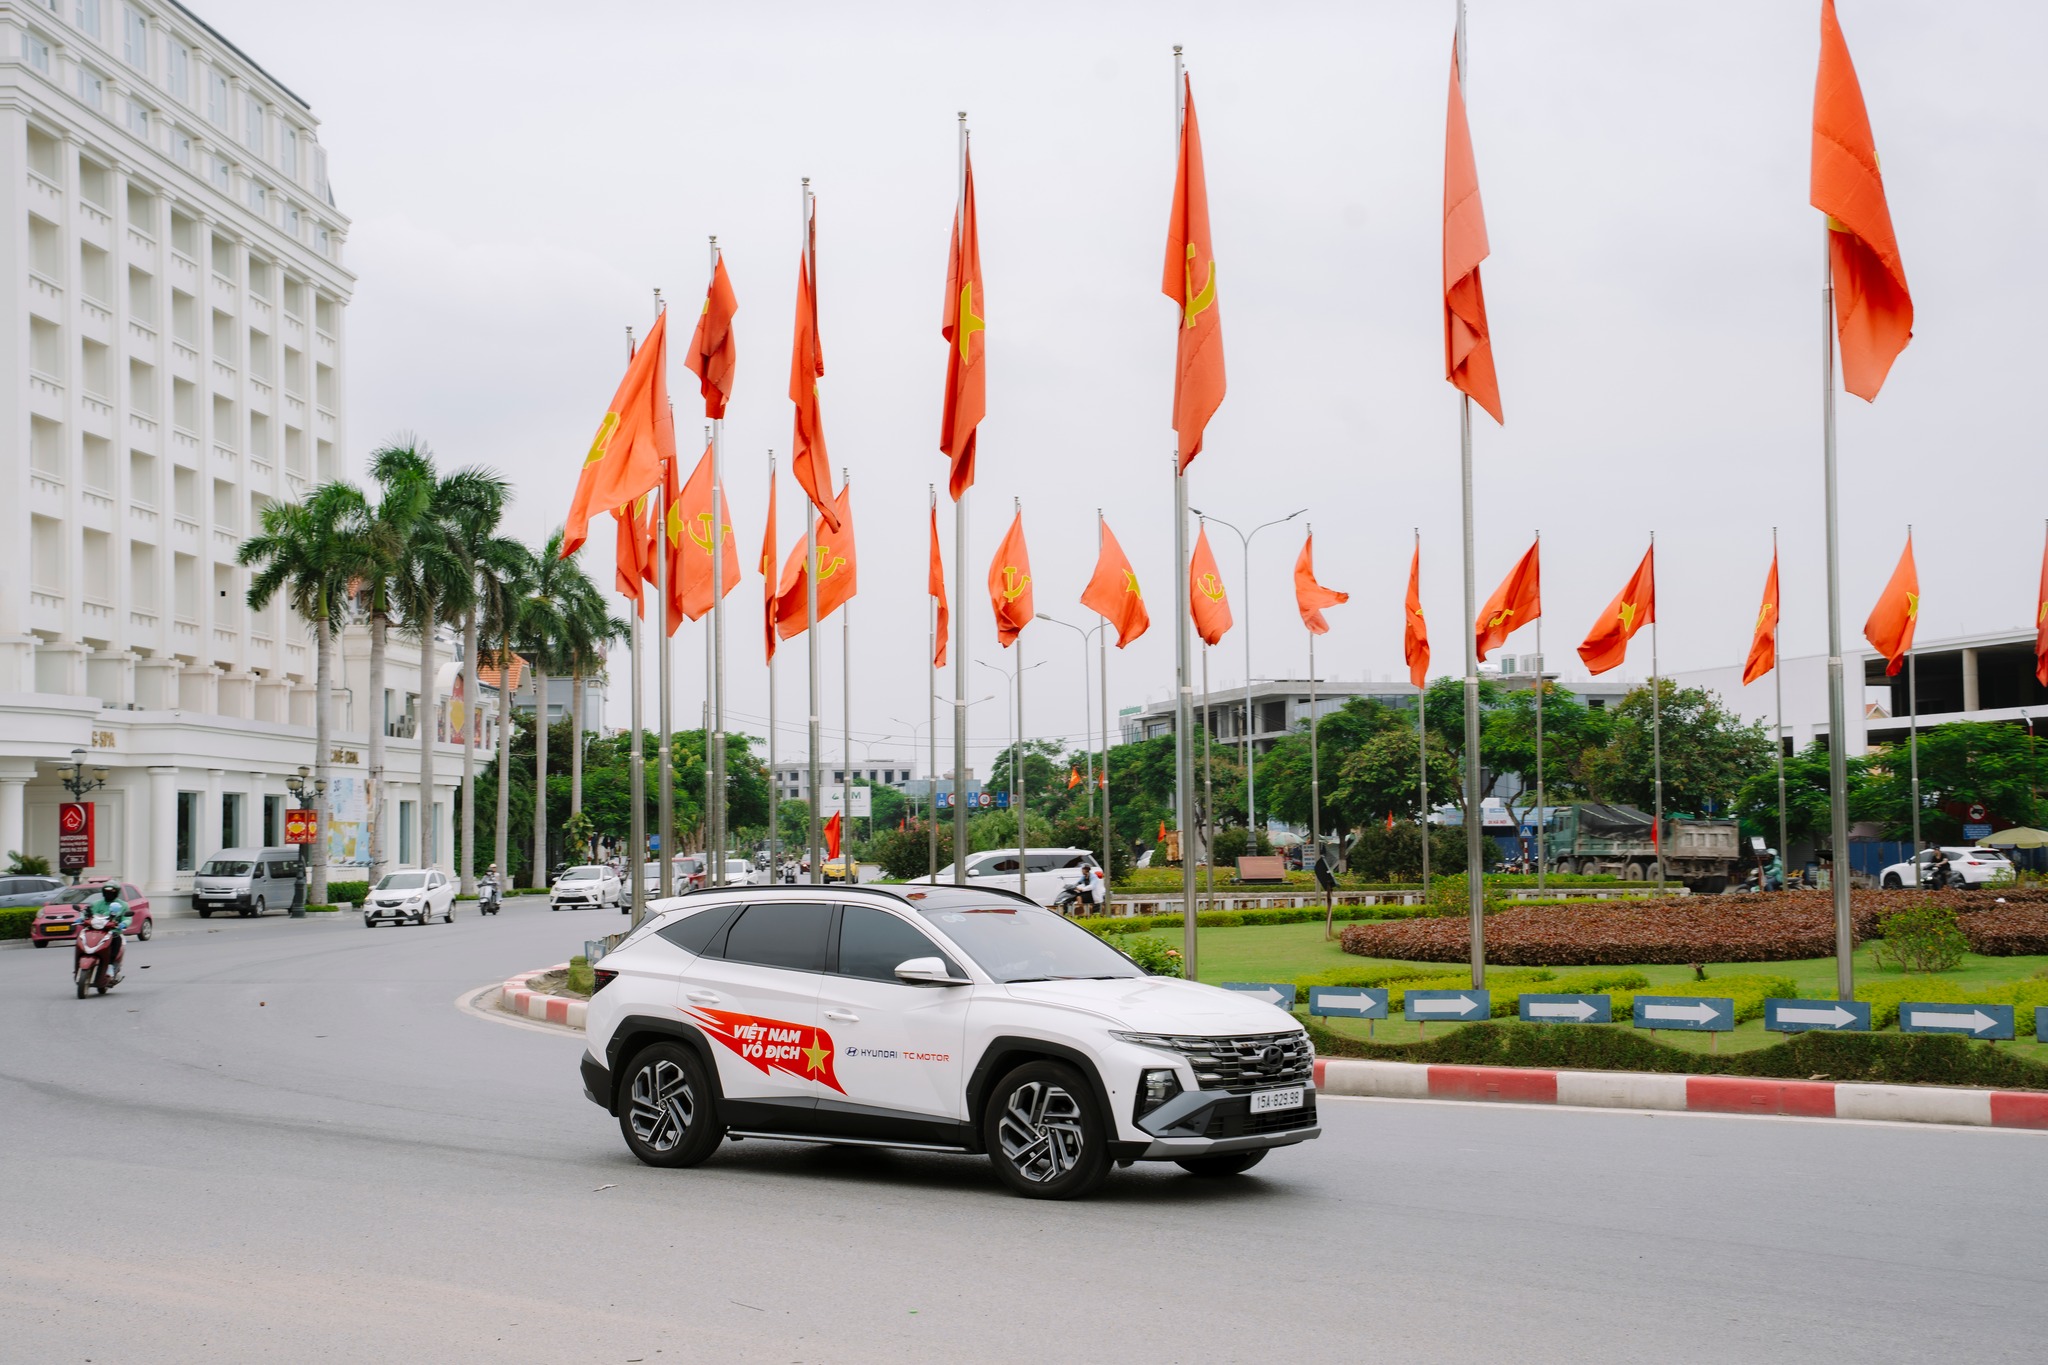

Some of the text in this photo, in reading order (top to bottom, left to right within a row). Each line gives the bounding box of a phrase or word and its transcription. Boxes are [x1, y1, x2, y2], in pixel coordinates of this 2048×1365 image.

[734, 1023, 801, 1043] VIỆT NAM
[742, 1041, 800, 1062] VÔ ĐỊCH
[861, 1049, 949, 1062] HYUNDAI TC MOTOR
[1257, 1091, 1299, 1109] 15A-829.98
